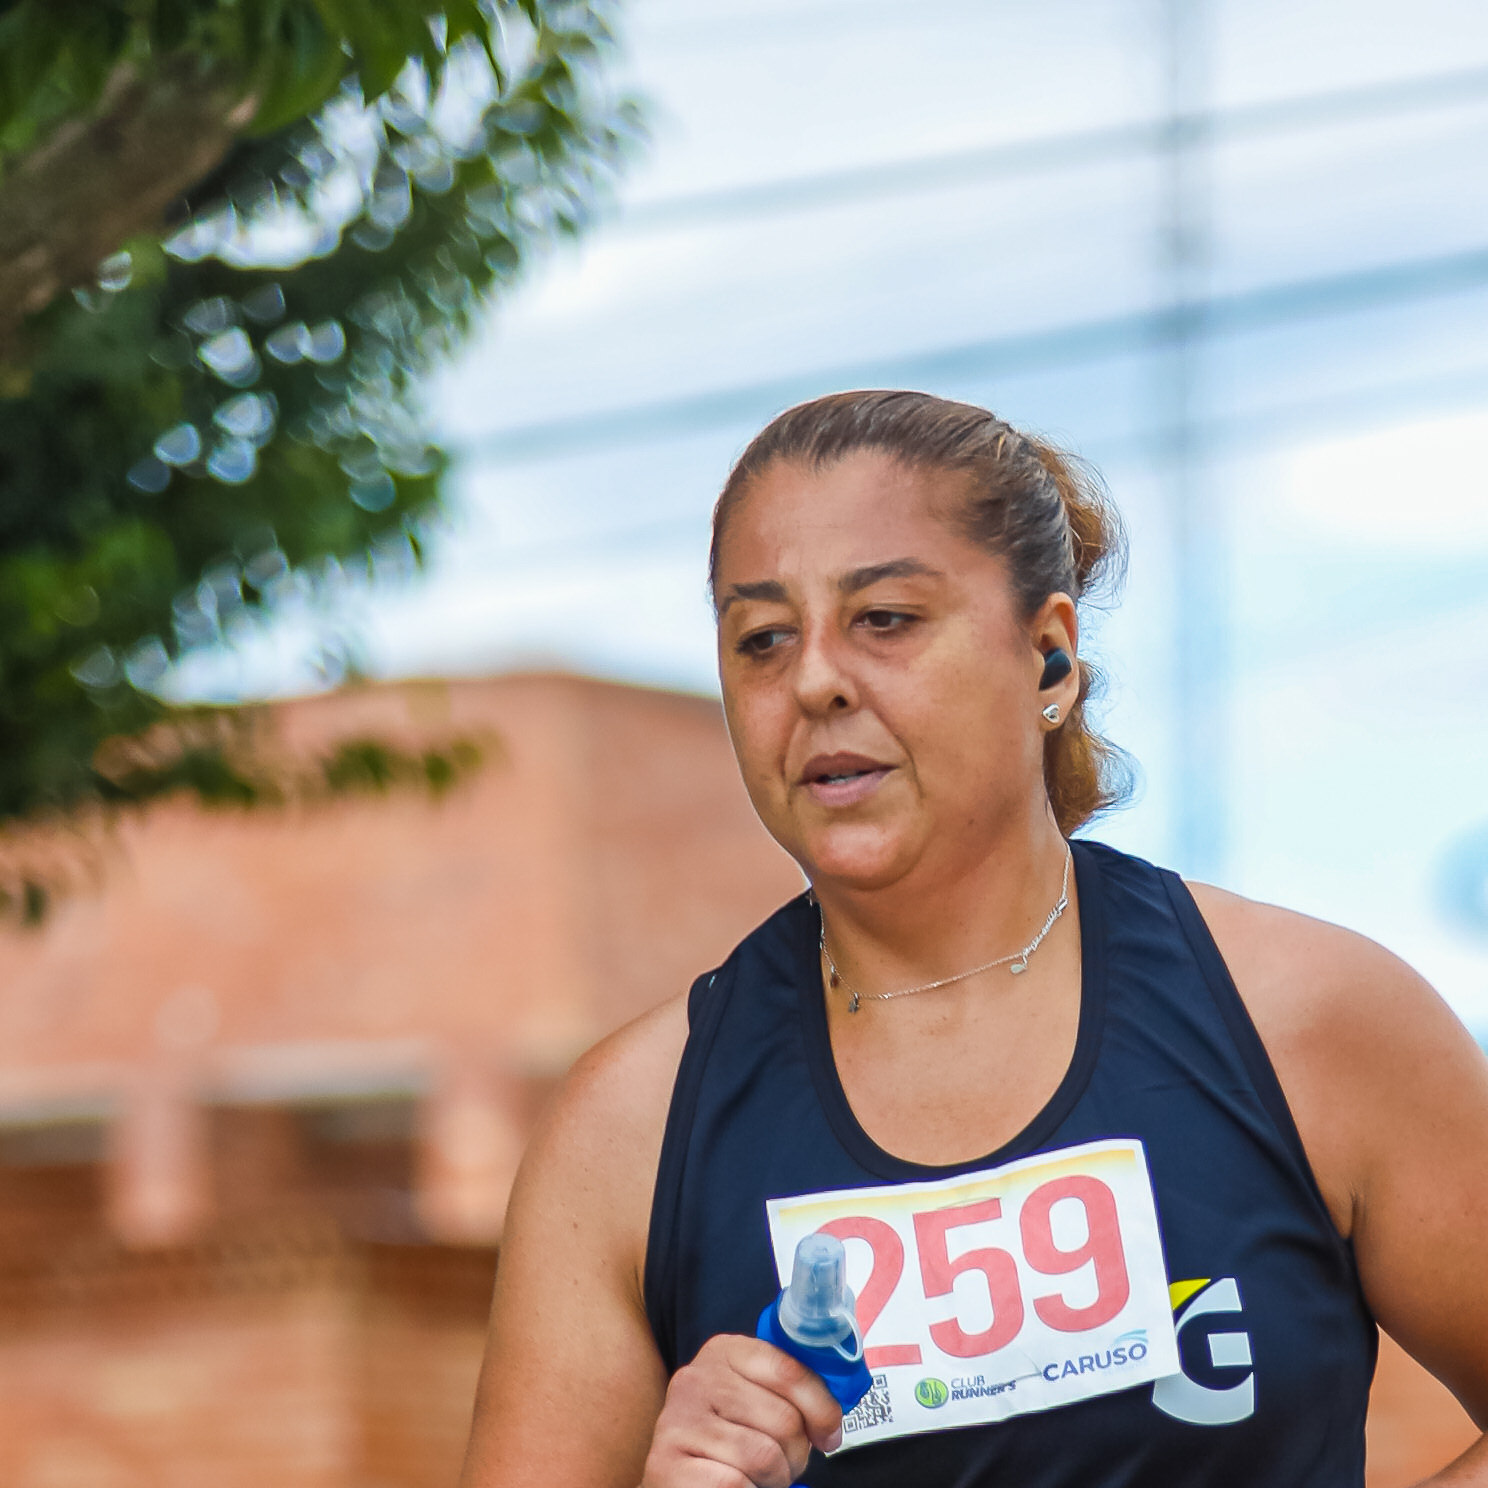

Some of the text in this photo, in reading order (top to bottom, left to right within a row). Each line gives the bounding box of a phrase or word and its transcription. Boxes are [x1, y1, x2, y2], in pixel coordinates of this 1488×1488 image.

[815, 1175, 1130, 1369] 259
[1043, 1343, 1148, 1381] CARUSO
[951, 1375, 985, 1389] CLUB
